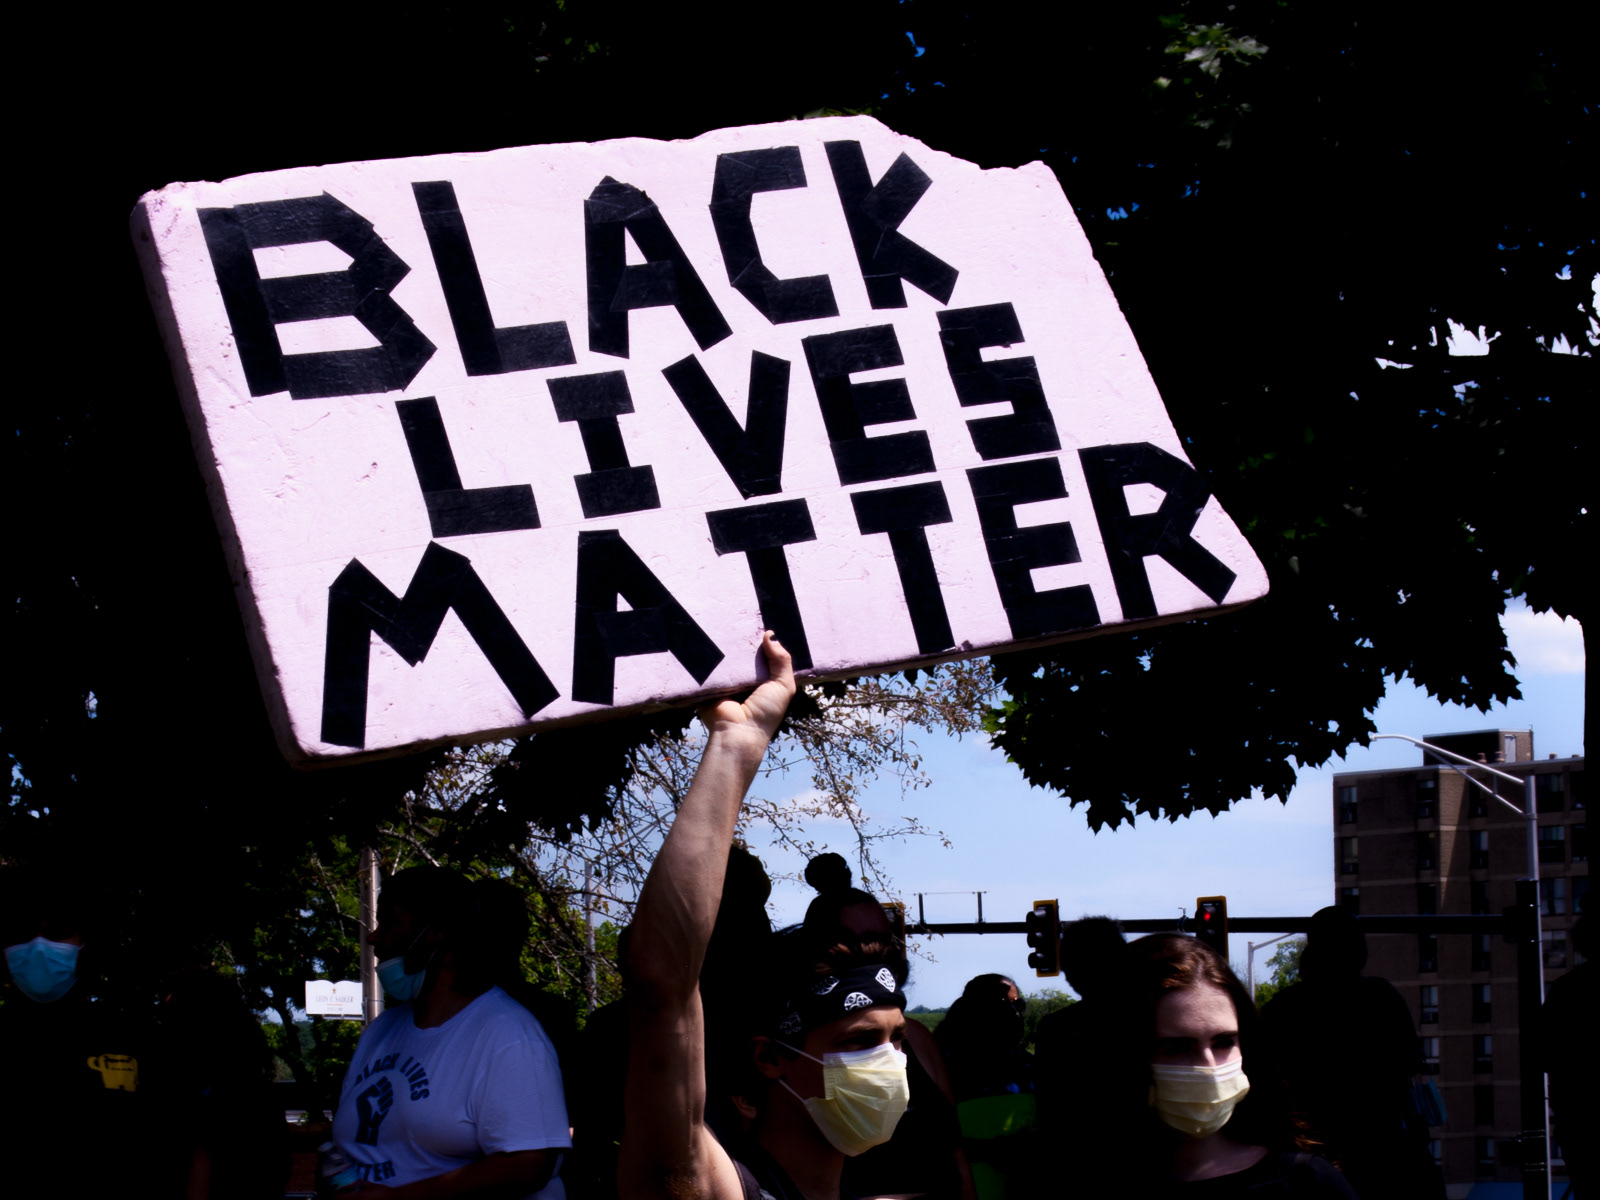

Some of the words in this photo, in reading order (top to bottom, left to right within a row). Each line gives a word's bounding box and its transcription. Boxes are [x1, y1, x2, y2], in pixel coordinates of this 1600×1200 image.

[196, 140, 959, 400] BLACK
[395, 302, 1062, 538] LIVES
[320, 442, 1237, 749] MATTER
[355, 1159, 396, 1182] TTER
[400, 1056, 430, 1101] LIVES
